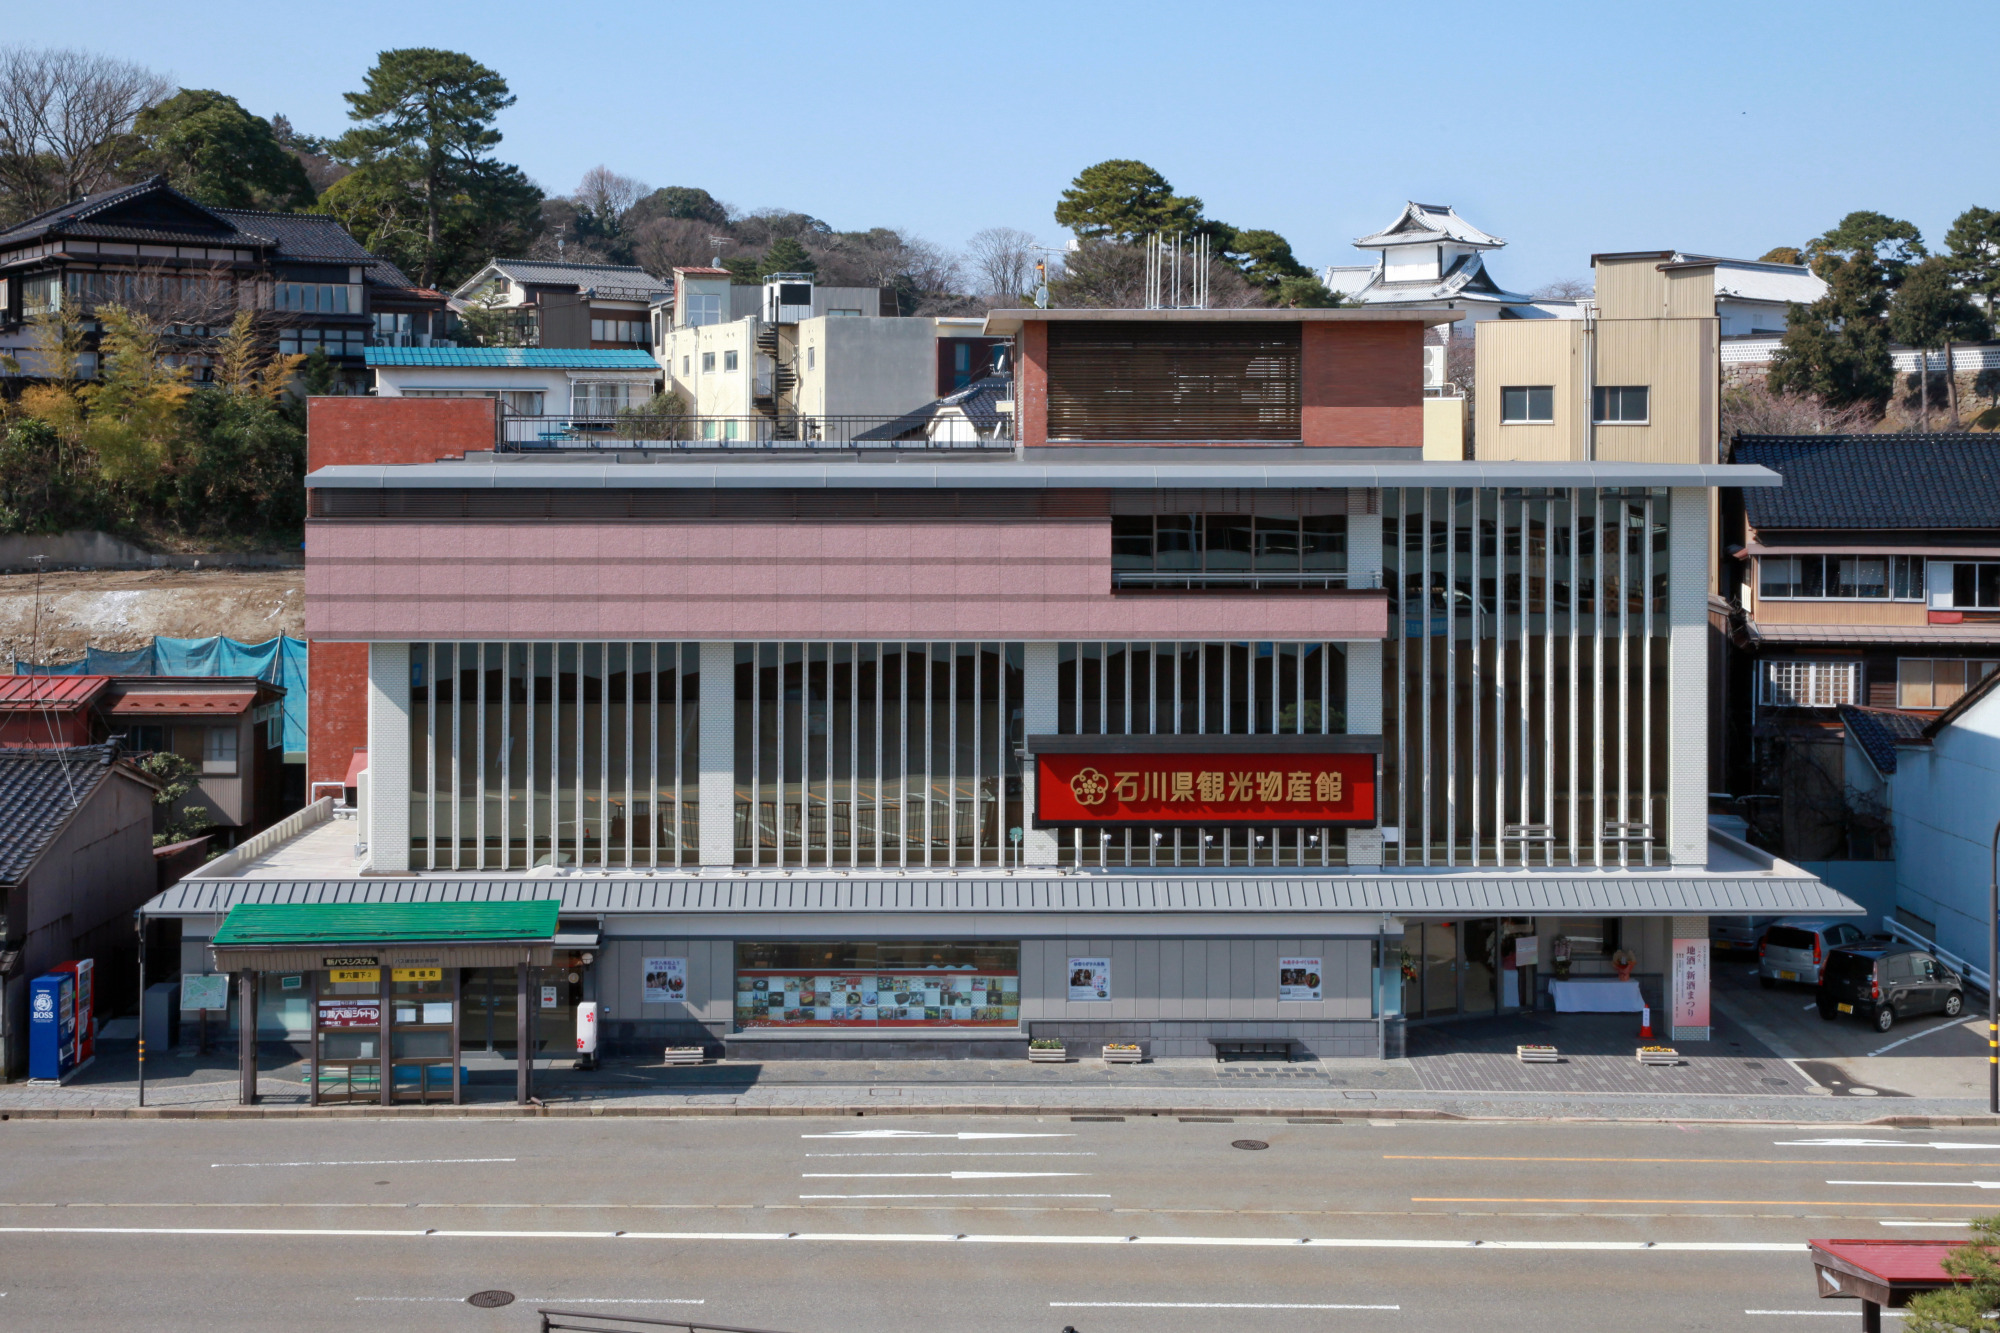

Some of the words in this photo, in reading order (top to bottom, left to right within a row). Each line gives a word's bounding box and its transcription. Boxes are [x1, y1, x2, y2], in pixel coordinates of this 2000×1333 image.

[1112, 771, 1342, 802] 石川県観光物産館
[326, 958, 375, 966] 新バスシステム
[1686, 945, 1696, 1017] 地酒・新酒まつり
